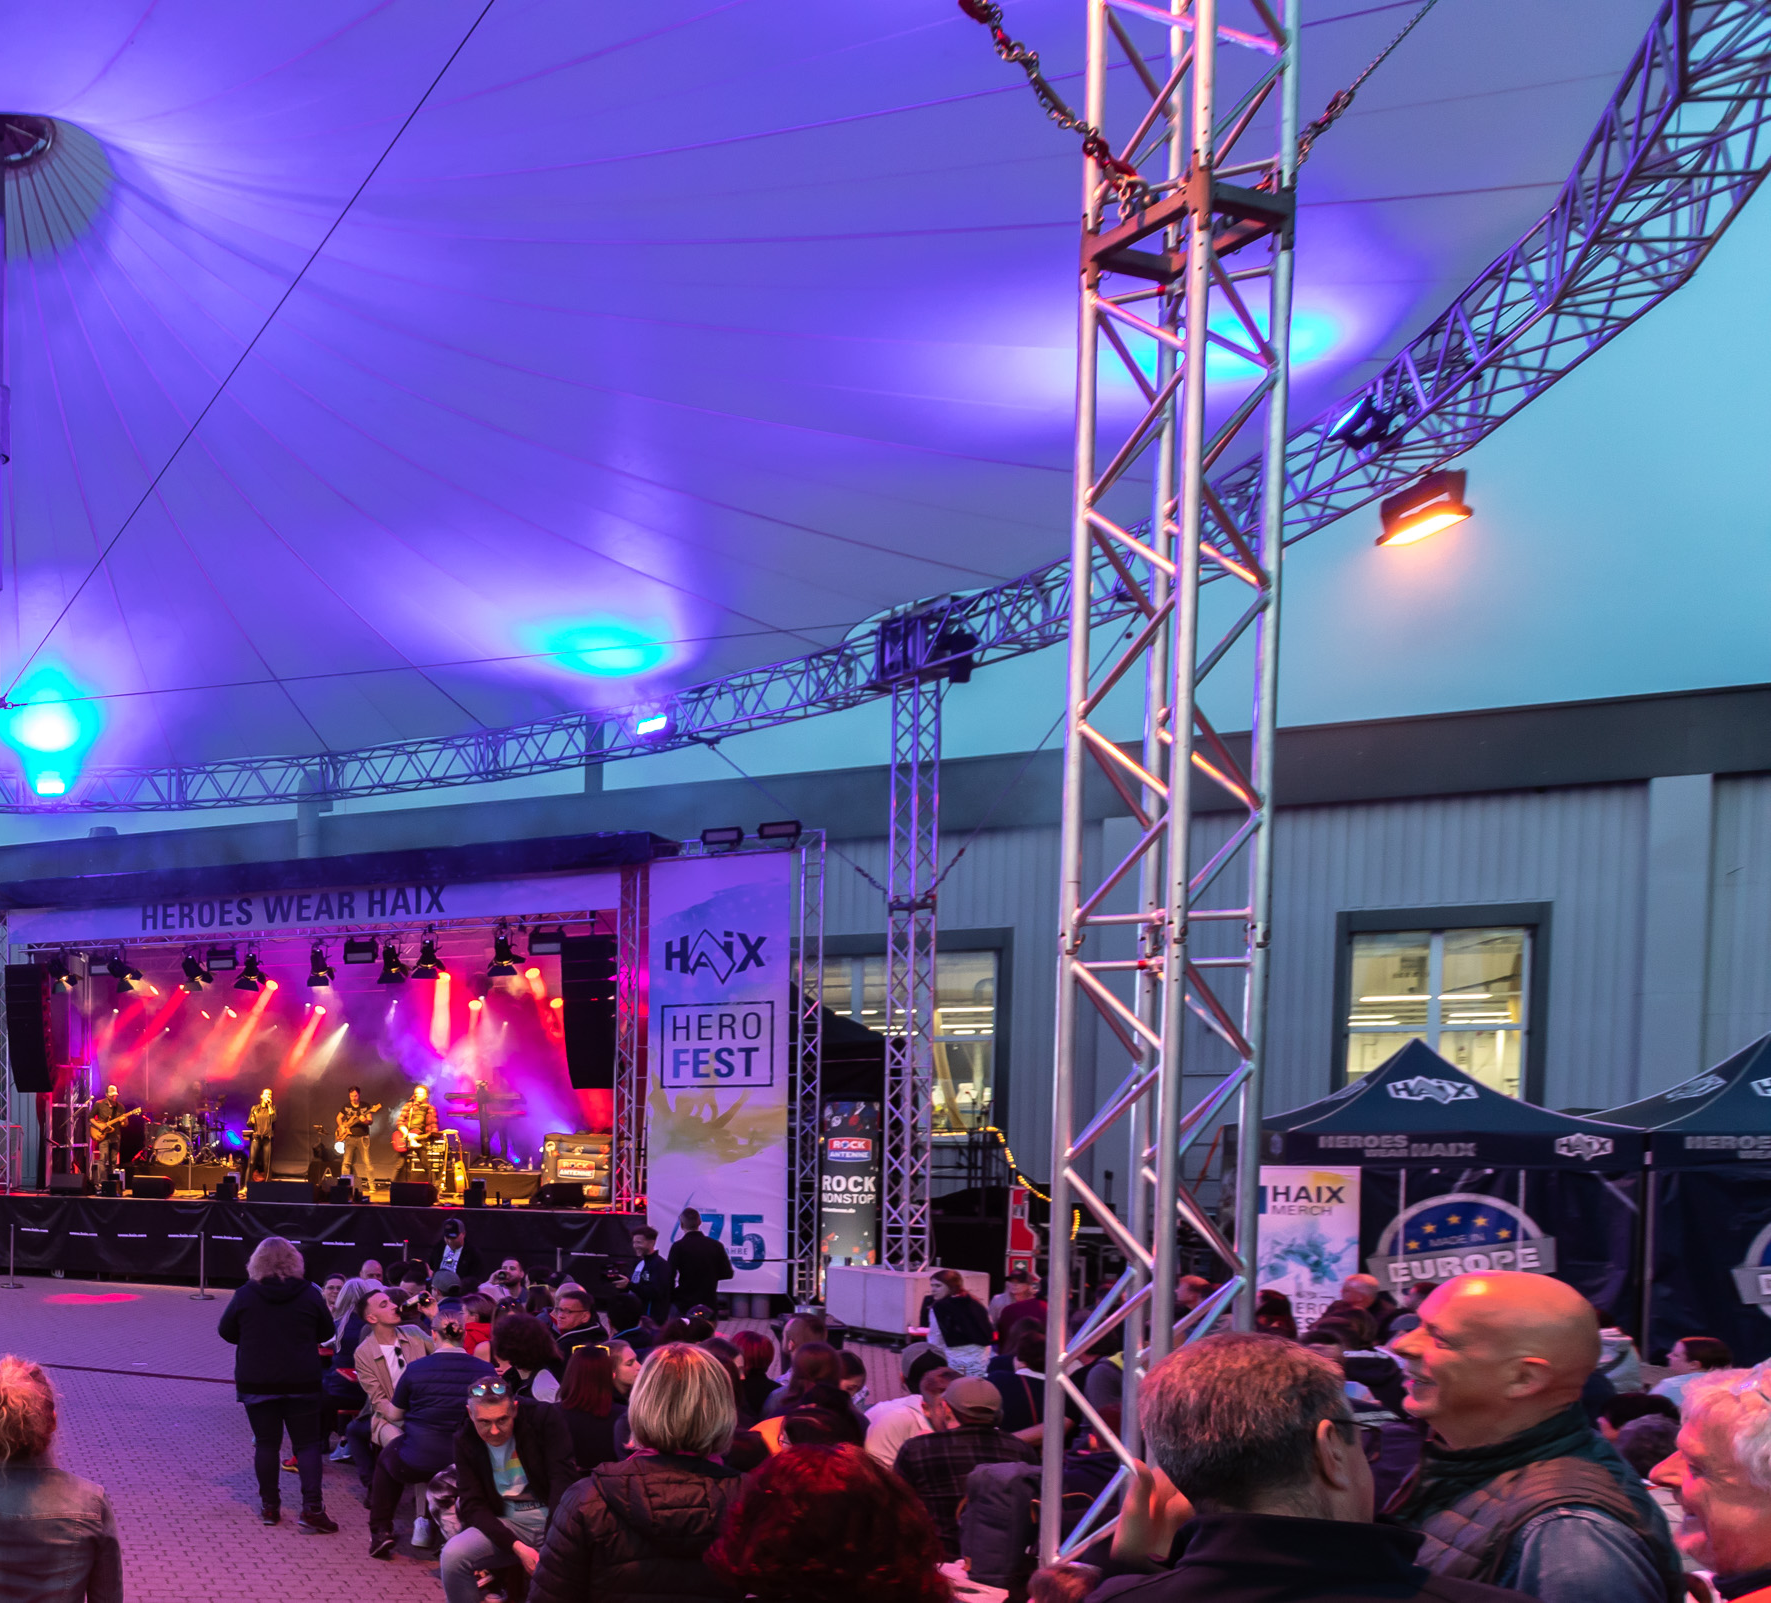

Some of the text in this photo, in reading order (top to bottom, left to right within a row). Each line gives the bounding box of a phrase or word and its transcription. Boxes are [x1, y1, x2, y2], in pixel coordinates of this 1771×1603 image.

[141, 885, 446, 931] HEROES WEAR HAIX
[665, 929, 768, 985] HAIX
[672, 1012, 762, 1042] HERO
[672, 1047, 760, 1079] FEST
[832, 1141, 866, 1149] ROCK
[1318, 1135, 1408, 1149] HEROES
[1411, 1143, 1476, 1157] HAIX
[1685, 1135, 1771, 1150] HEROE
[562, 1161, 589, 1169] ROCK
[822, 1175, 876, 1192] ROCK
[1272, 1186, 1345, 1203] HAIX
[1272, 1205, 1333, 1216] MERCH
[1430, 1235, 1467, 1247] MADE
[1388, 1247, 1541, 1283] EUROPE
